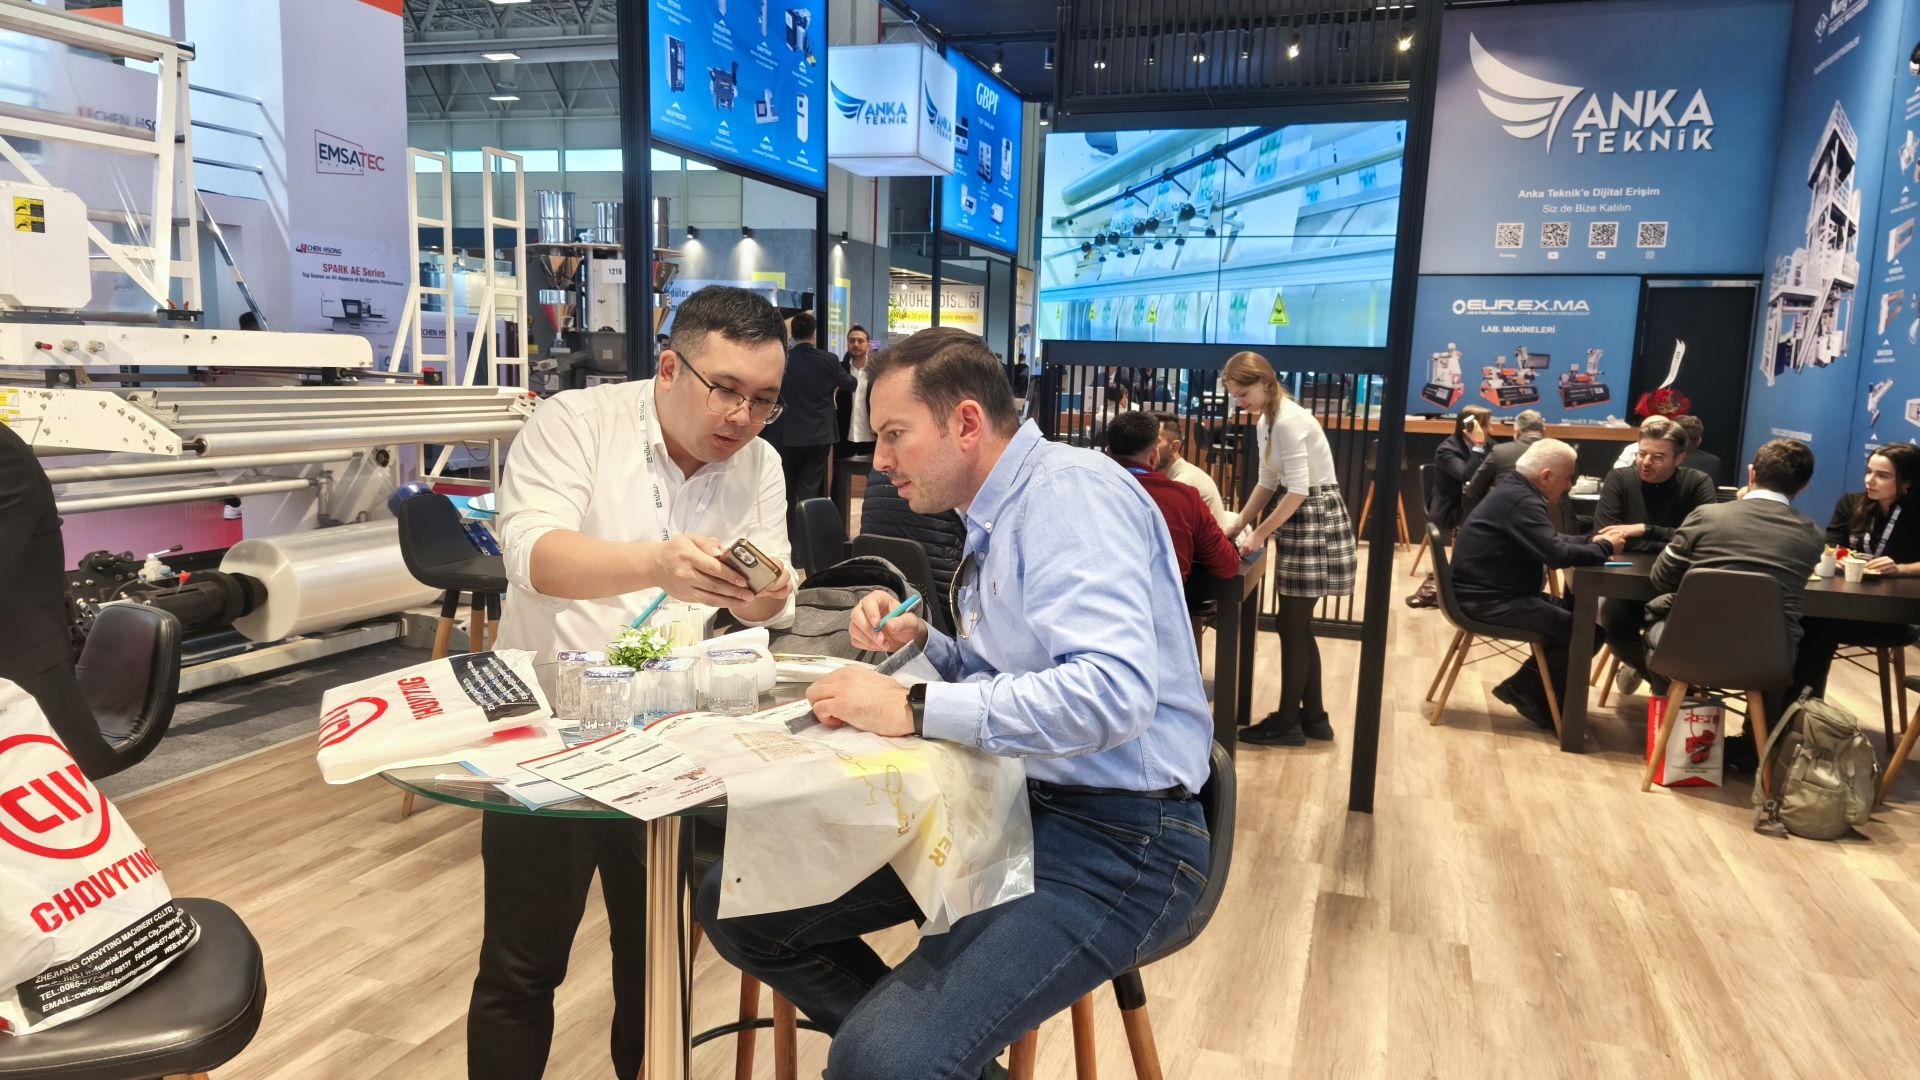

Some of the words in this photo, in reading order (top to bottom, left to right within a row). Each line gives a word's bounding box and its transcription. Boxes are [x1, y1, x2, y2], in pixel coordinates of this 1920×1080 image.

[975, 82, 999, 116] GBPI
[864, 101, 908, 116] ANKA
[1572, 87, 1715, 130] ANKA
[1571, 127, 1713, 154] TEKNİK
[318, 142, 385, 172] EMSATEC
[1518, 189, 1544, 199] Anka
[1548, 188, 1590, 198] Teknik'e
[1593, 187, 1622, 200] Dijital
[1543, 204, 1557, 213] Siz
[1560, 204, 1572, 213] de
[1575, 203, 1597, 213] Bize
[307, 244, 321, 253] CHEN
[323, 246, 342, 255] HSONG
[322, 263, 348, 275] SPARK
[351, 265, 361, 276] AE
[362, 267, 386, 279] Series
[422, 329, 437, 337] CHEN
[1482, 325, 1500, 333] LAB.
[1503, 323, 1556, 334] MAKİNELERİ
[35, 962, 80, 984] ZHEJIANG
[80, 937, 122, 966] CHOVYTING
[121, 917, 153, 941] MACHINERY
